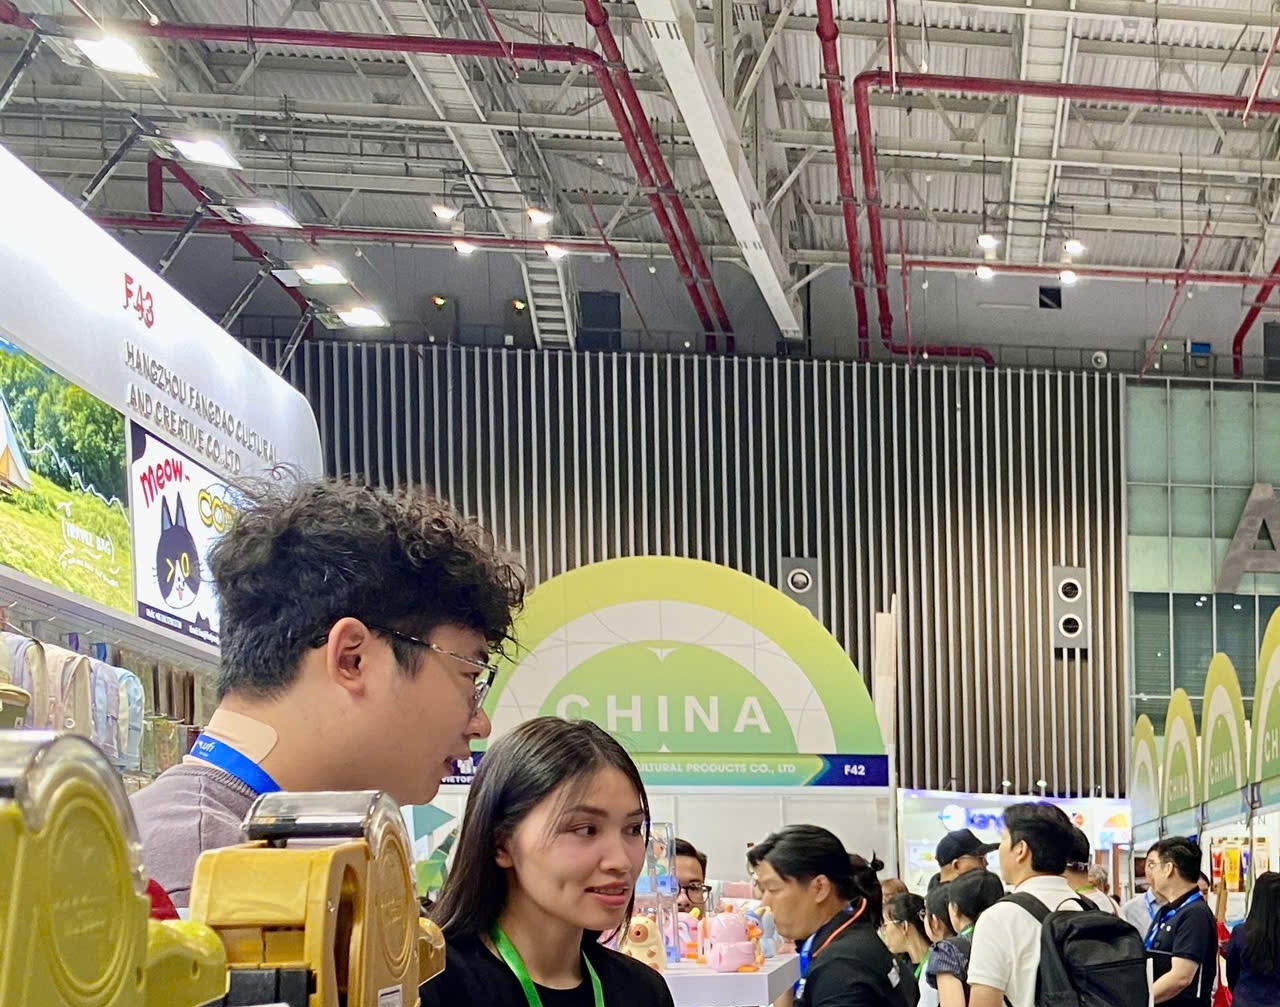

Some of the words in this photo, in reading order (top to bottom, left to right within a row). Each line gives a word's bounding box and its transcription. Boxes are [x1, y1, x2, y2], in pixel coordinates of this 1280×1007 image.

[123, 272, 155, 328] F43
[125, 340, 187, 404] HANGZHOU
[188, 383, 236, 436] FANGDAO
[126, 384, 154, 418] AND
[154, 401, 205, 453] CREATIVE
[555, 694, 772, 734] CHINA
[686, 764, 748, 774] PRODUCTS
[777, 764, 796, 774] LTD
[844, 764, 866, 776] F42
[1210, 749, 1235, 785] CHINA
